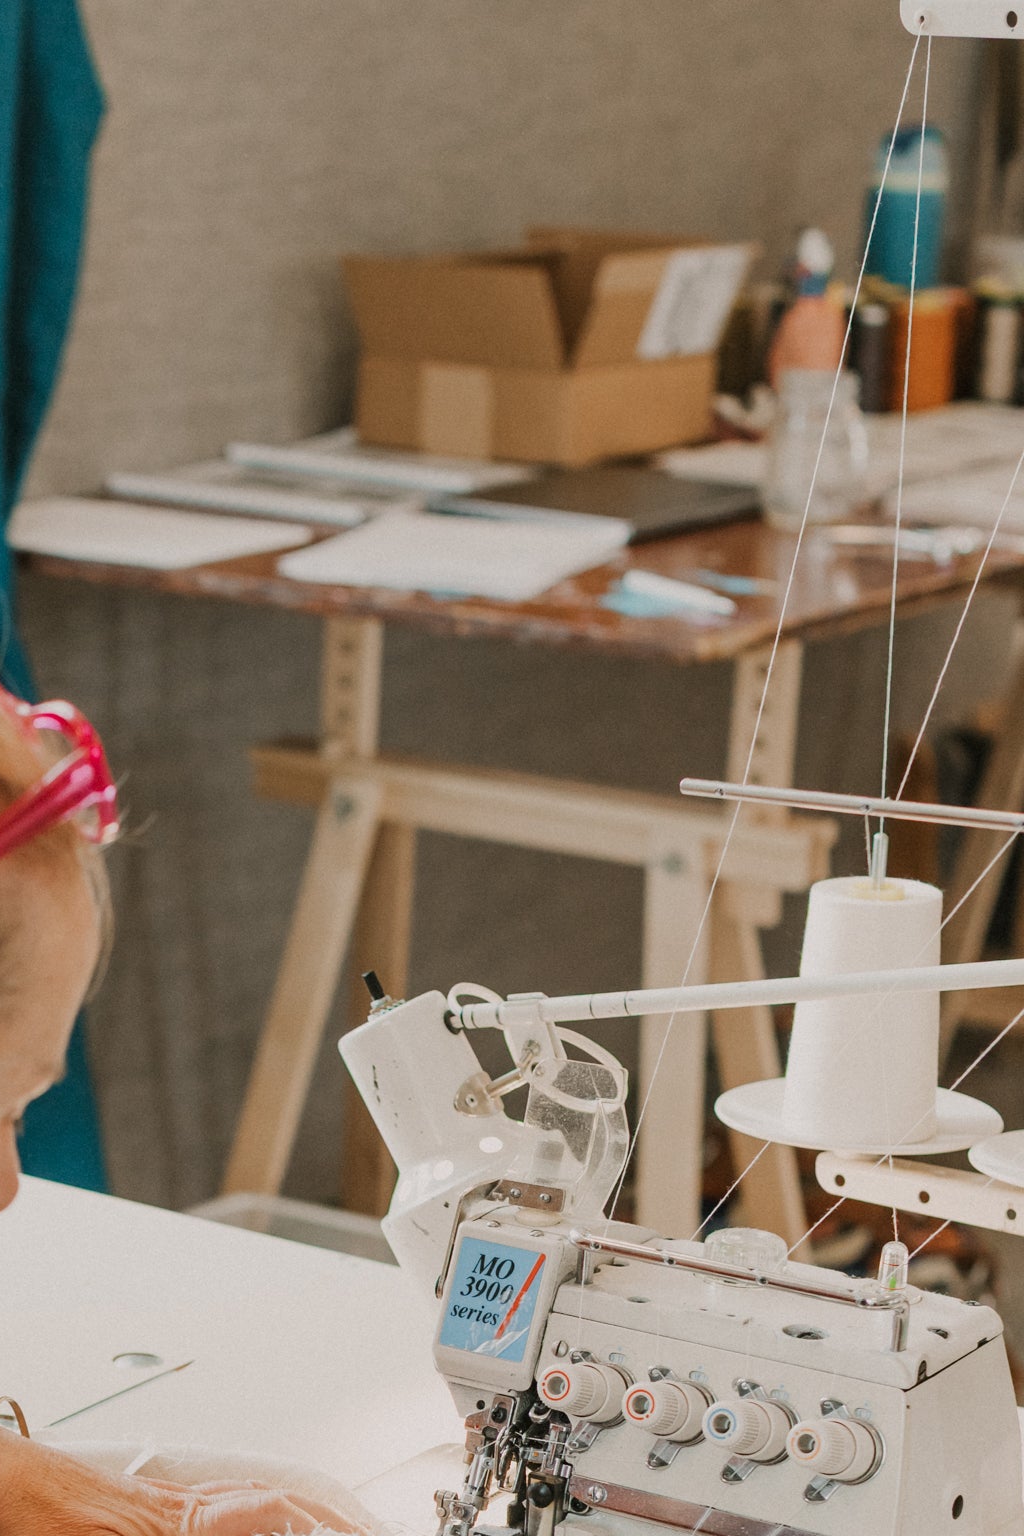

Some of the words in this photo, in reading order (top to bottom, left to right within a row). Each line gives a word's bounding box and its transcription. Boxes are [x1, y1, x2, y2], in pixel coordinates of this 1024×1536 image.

[472, 1253, 515, 1280] MO
[460, 1276, 514, 1305] 3900
[450, 1304, 500, 1326] series
